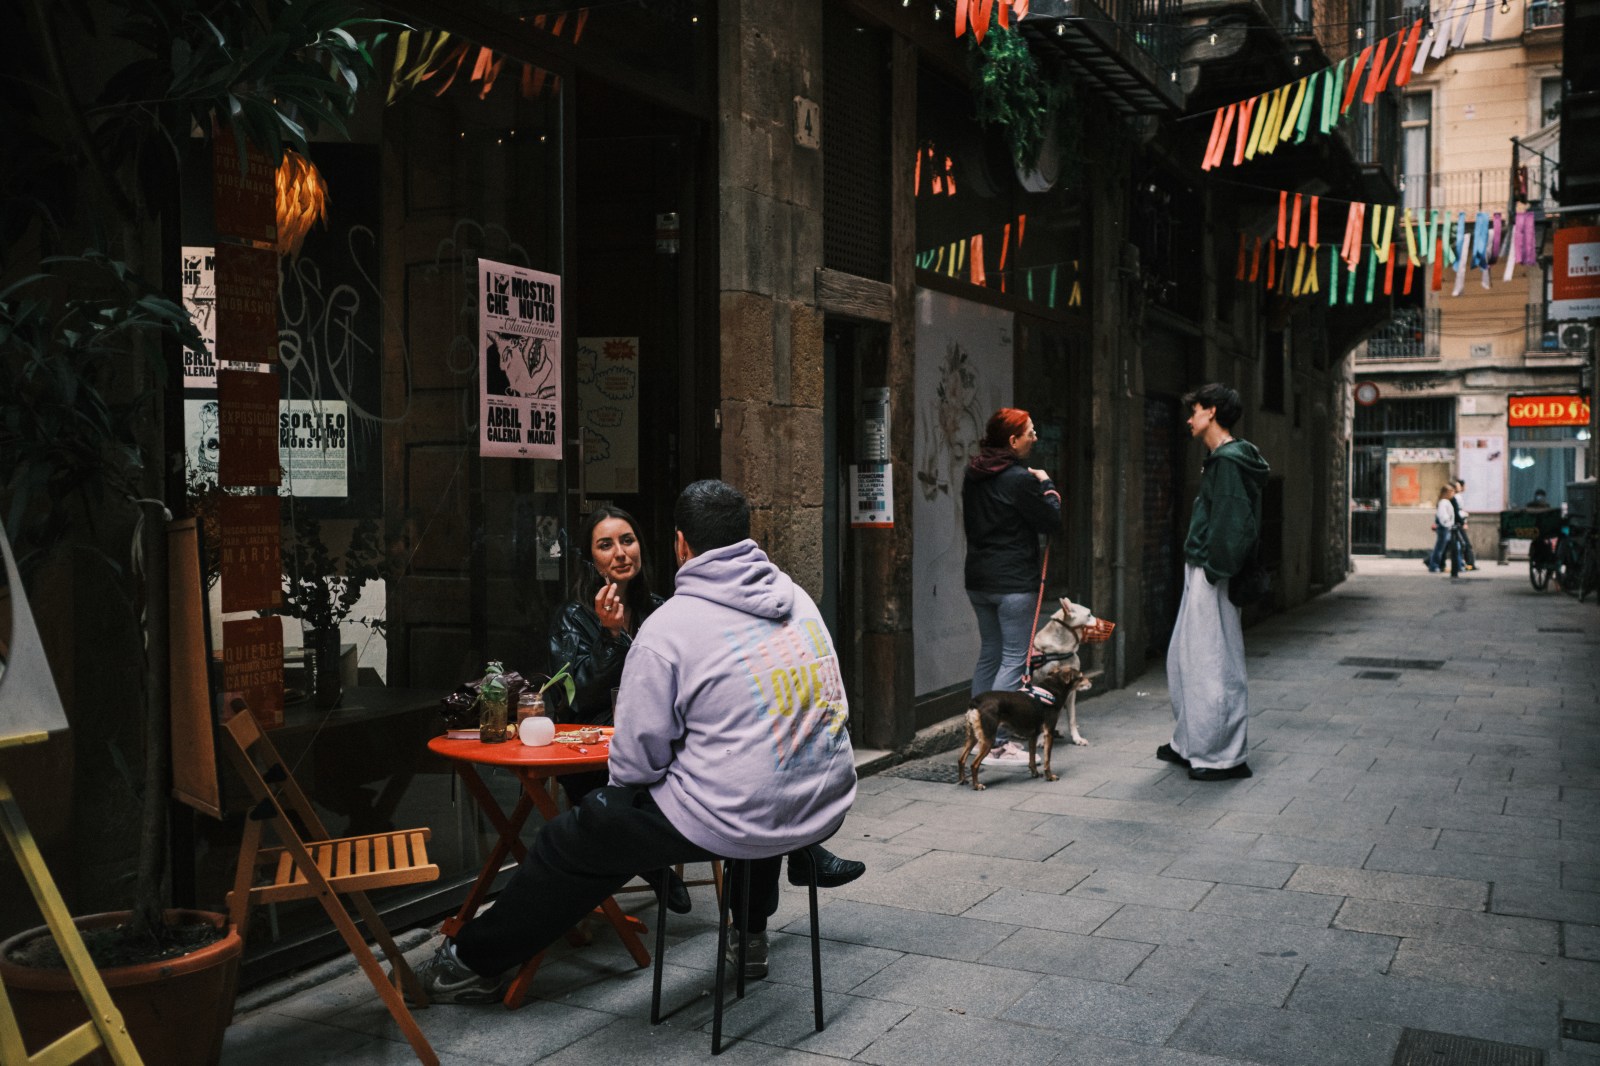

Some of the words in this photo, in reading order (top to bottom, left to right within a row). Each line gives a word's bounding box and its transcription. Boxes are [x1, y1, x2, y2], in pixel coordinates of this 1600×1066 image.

[182, 270, 201, 285] HE
[487, 272, 490, 292] I
[512, 277, 554, 304] MOSTRI
[487, 292, 510, 316] CHE
[519, 298, 554, 324] NUTRO
[184, 366, 216, 377] ALERIA
[487, 406, 522, 428] ABRIL
[530, 410, 556, 430] 10-12
[1510, 402, 1564, 418] GOLD
[280, 412, 346, 428] SORTEO
[280, 438, 346, 448] MONSTUO
[487, 428, 522, 443] GALERIA
[527, 430, 556, 445] MARZIA
[223, 546, 280, 563] MARCA
[226, 642, 282, 662] QUIERES
[226, 669, 283, 689] CAMISETAS
